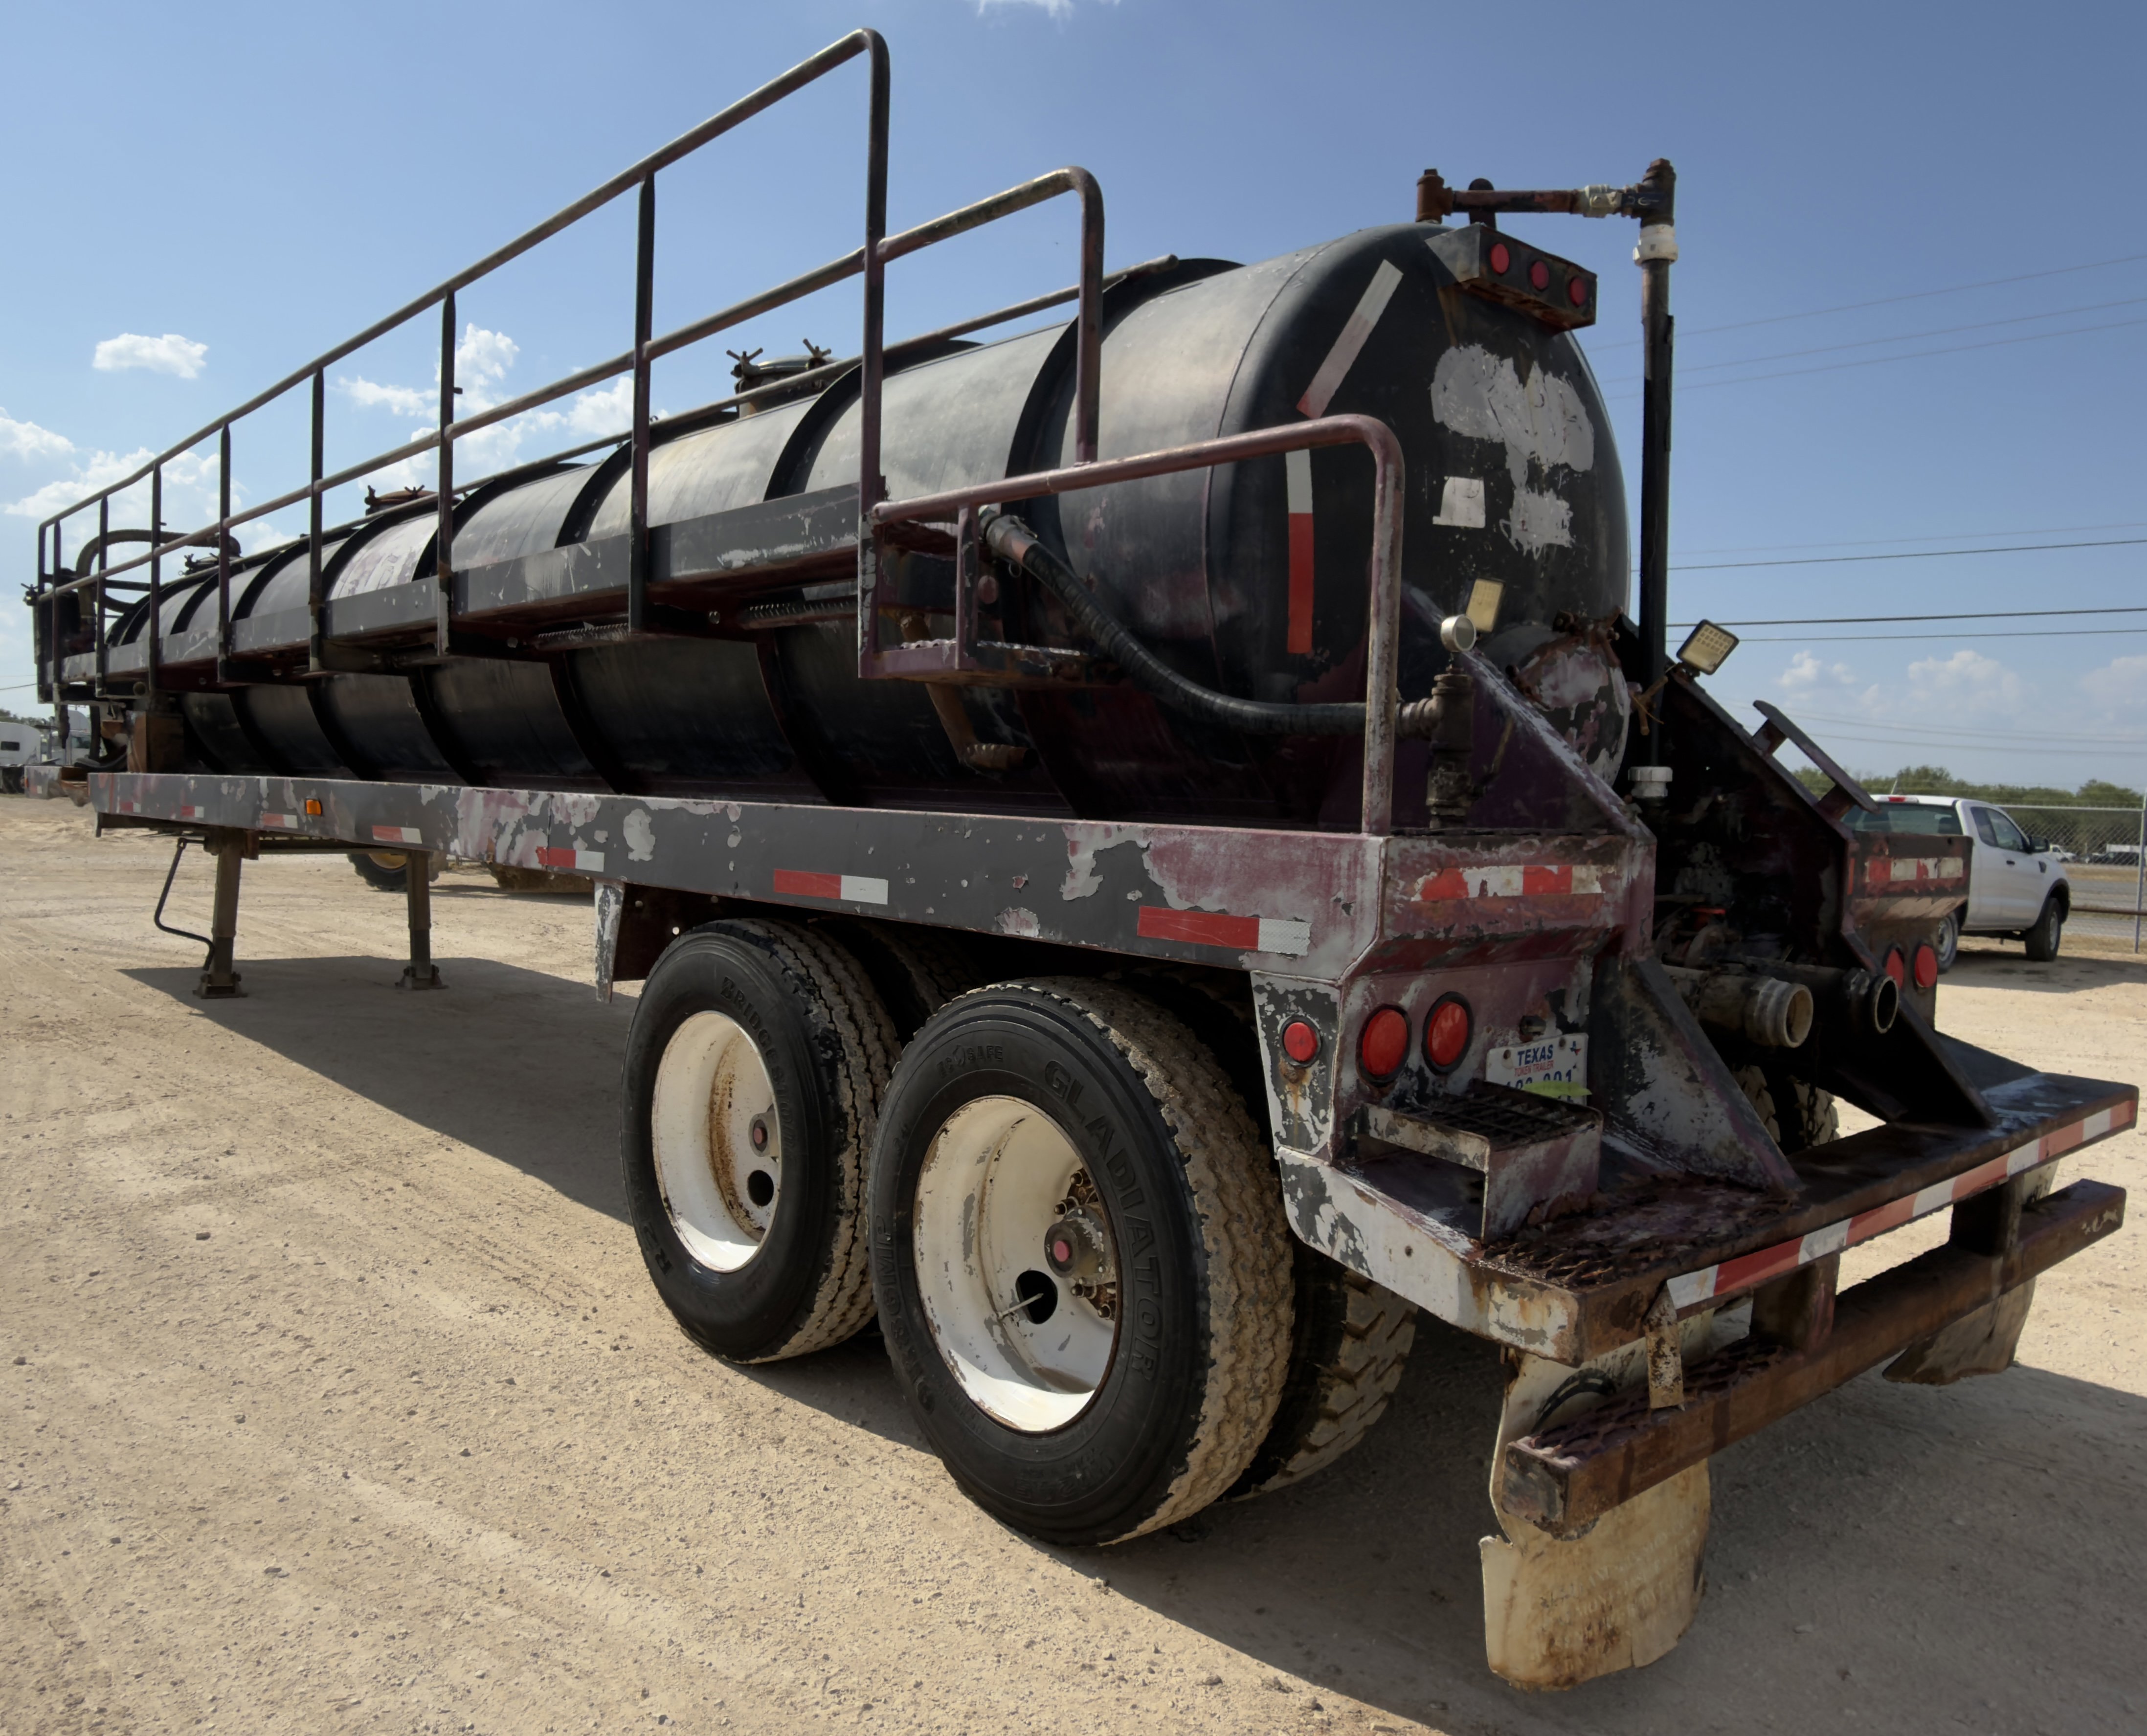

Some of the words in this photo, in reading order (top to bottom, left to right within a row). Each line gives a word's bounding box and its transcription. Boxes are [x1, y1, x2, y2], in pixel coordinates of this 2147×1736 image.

[1518, 1044, 1553, 1066] TEXAS
[1533, 1060, 1554, 1072] TRAILER
[1044, 1060, 1163, 1381] GLADIATOR
